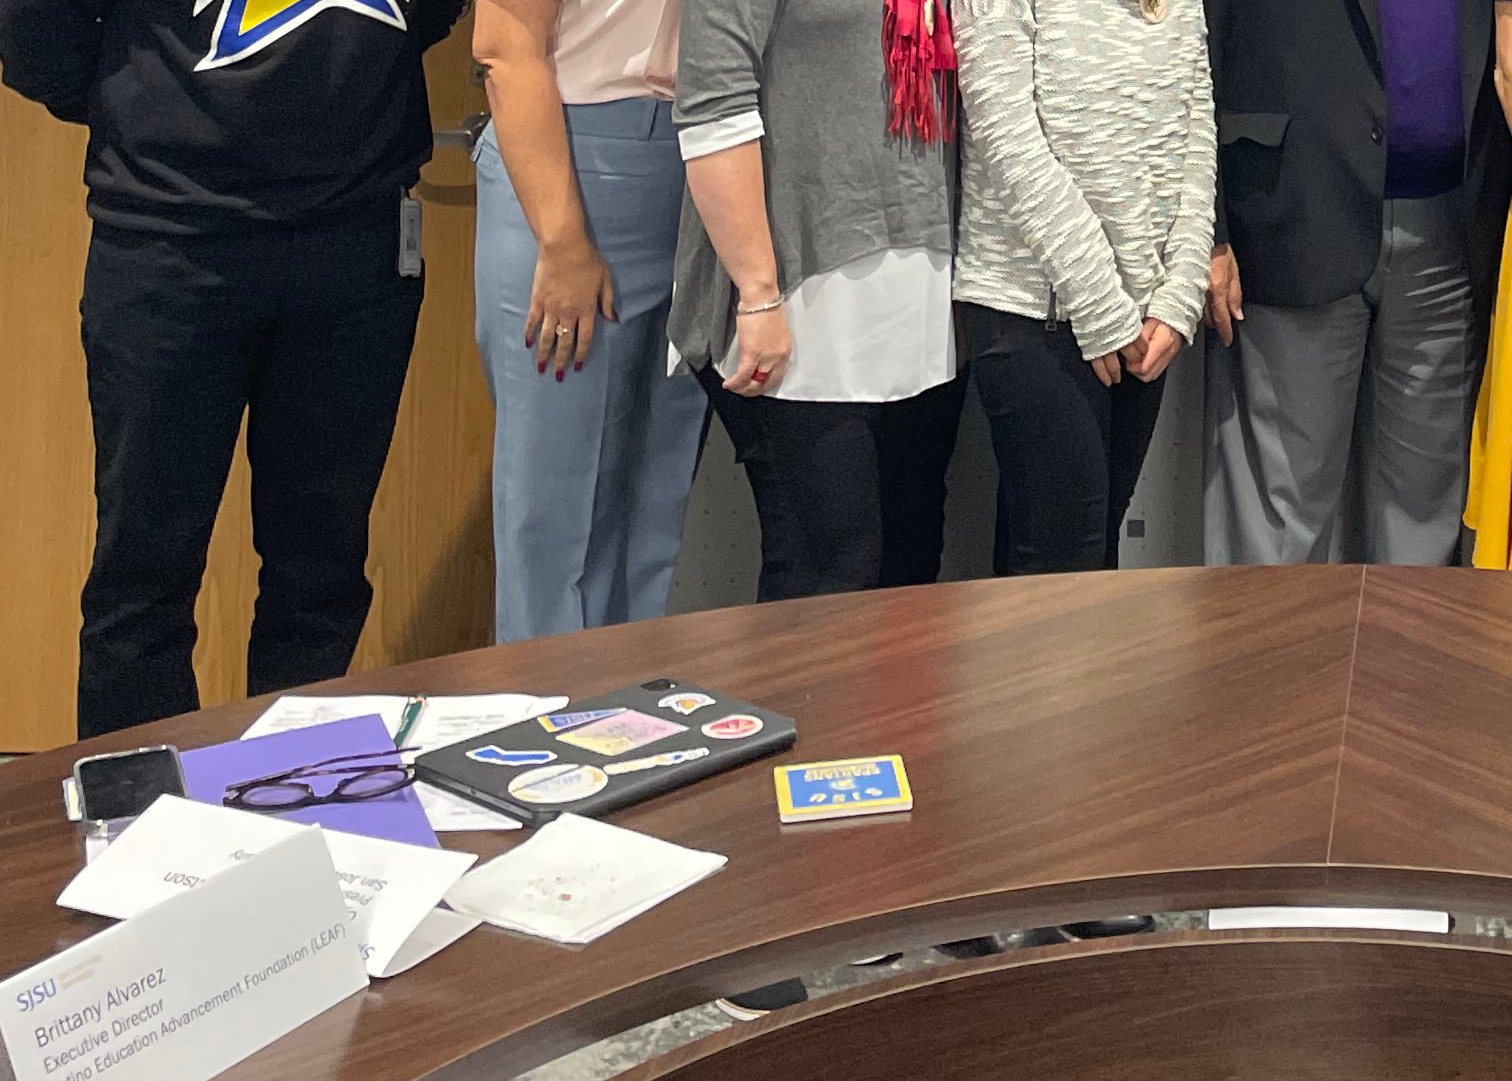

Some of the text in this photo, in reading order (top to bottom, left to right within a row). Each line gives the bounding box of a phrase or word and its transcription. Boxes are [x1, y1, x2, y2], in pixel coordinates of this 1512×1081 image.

[16, 978, 57, 1012] SJSU
[34, 1001, 101, 1048] Brittany
[106, 968, 166, 1011] Alvarez
[94, 1030, 159, 1073] Education
[160, 982, 243, 1037] Advancement
[243, 945, 309, 990] Foundation
[310, 923, 346, 955] (LEAF)
[43, 998, 164, 1074] Executive Director
